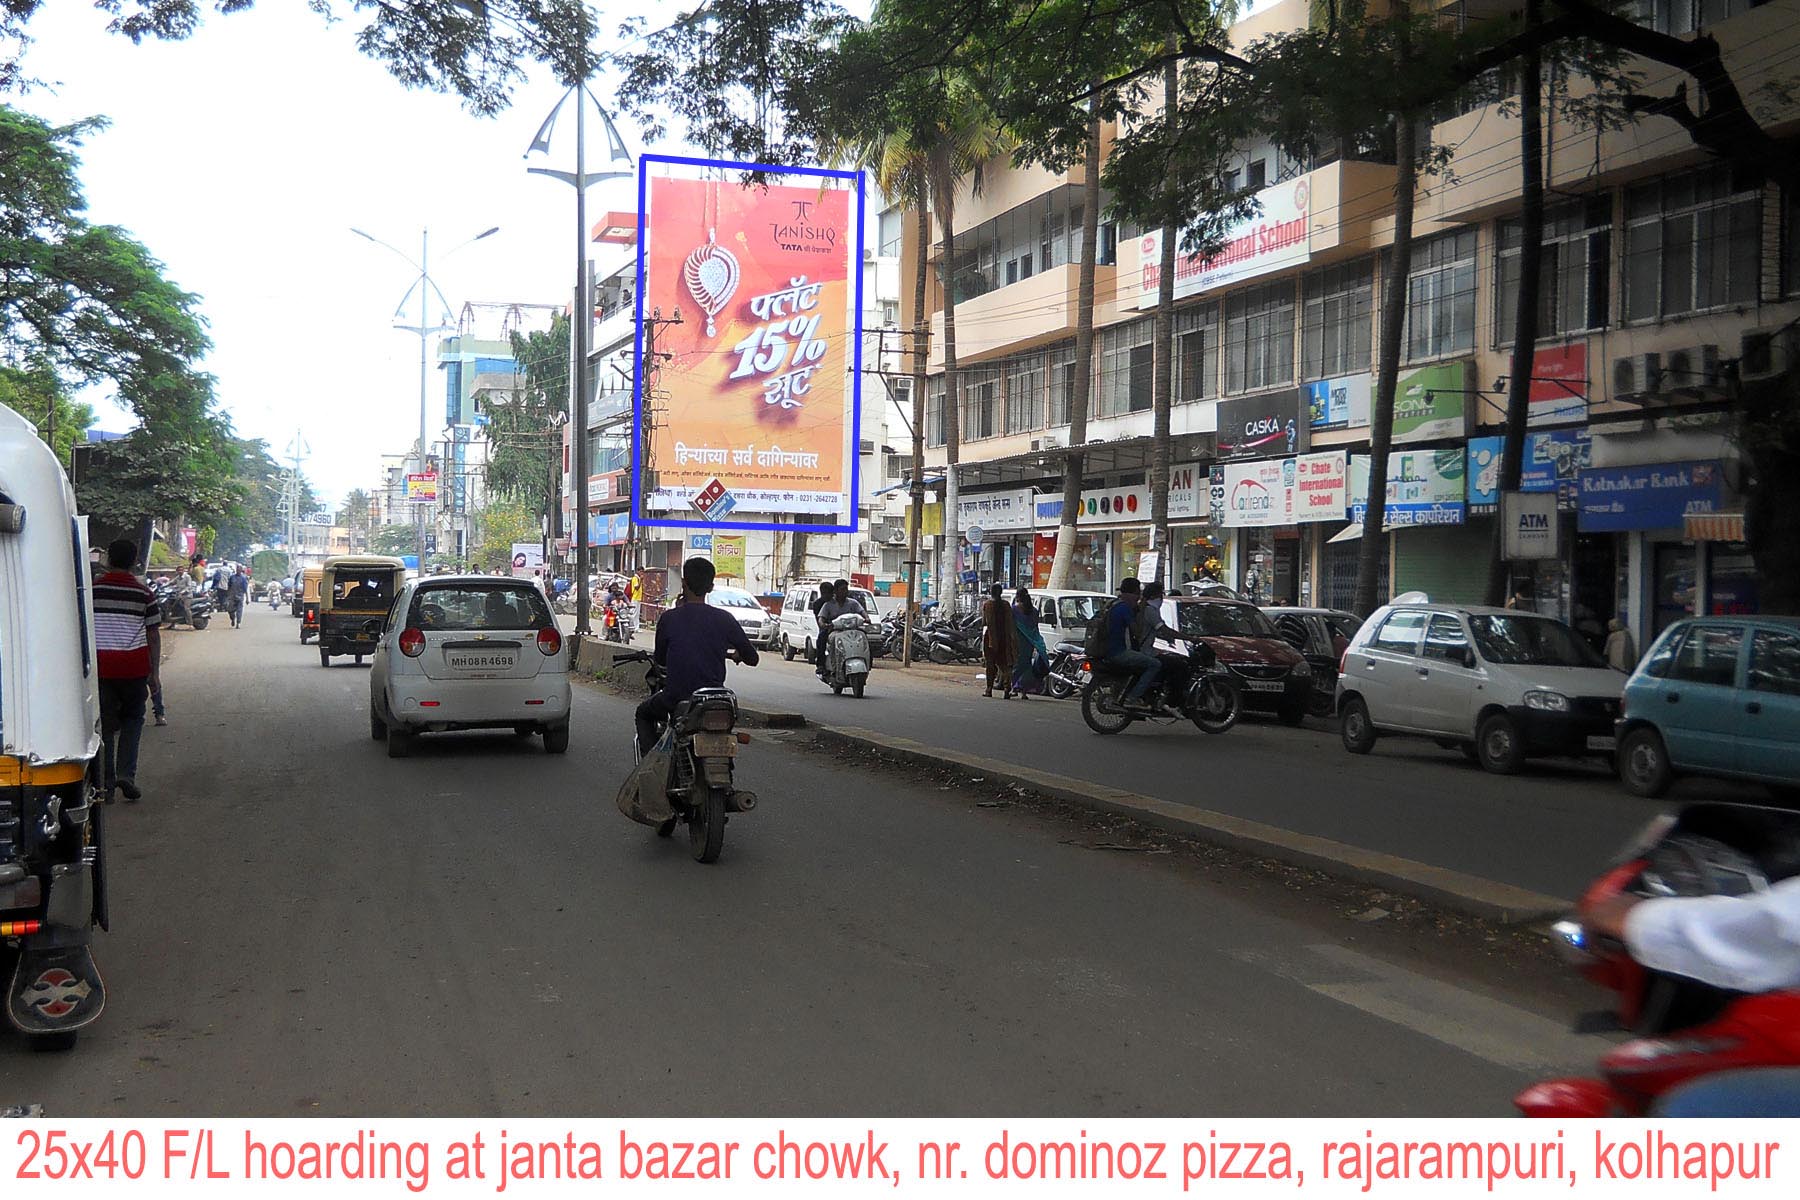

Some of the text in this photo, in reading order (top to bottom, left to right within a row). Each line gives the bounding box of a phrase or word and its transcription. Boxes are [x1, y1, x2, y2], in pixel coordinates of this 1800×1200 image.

[769, 222, 835, 246] TANISHQ
[781, 244, 802, 252] TATA
[1143, 262, 1161, 291] Cha
[1258, 210, 1307, 256] School
[729, 313, 827, 379] 15%
[1245, 416, 1280, 436] CASKA
[732, 444, 754, 466] सर्व
[1299, 476, 1344, 492] International
[1583, 471, 1690, 493] Ratnakar Bank
[800, 494, 812, 503] 0231
[1309, 493, 1333, 507] School
[1685, 499, 1713, 514] ATM
[1519, 513, 1549, 528] ATM
